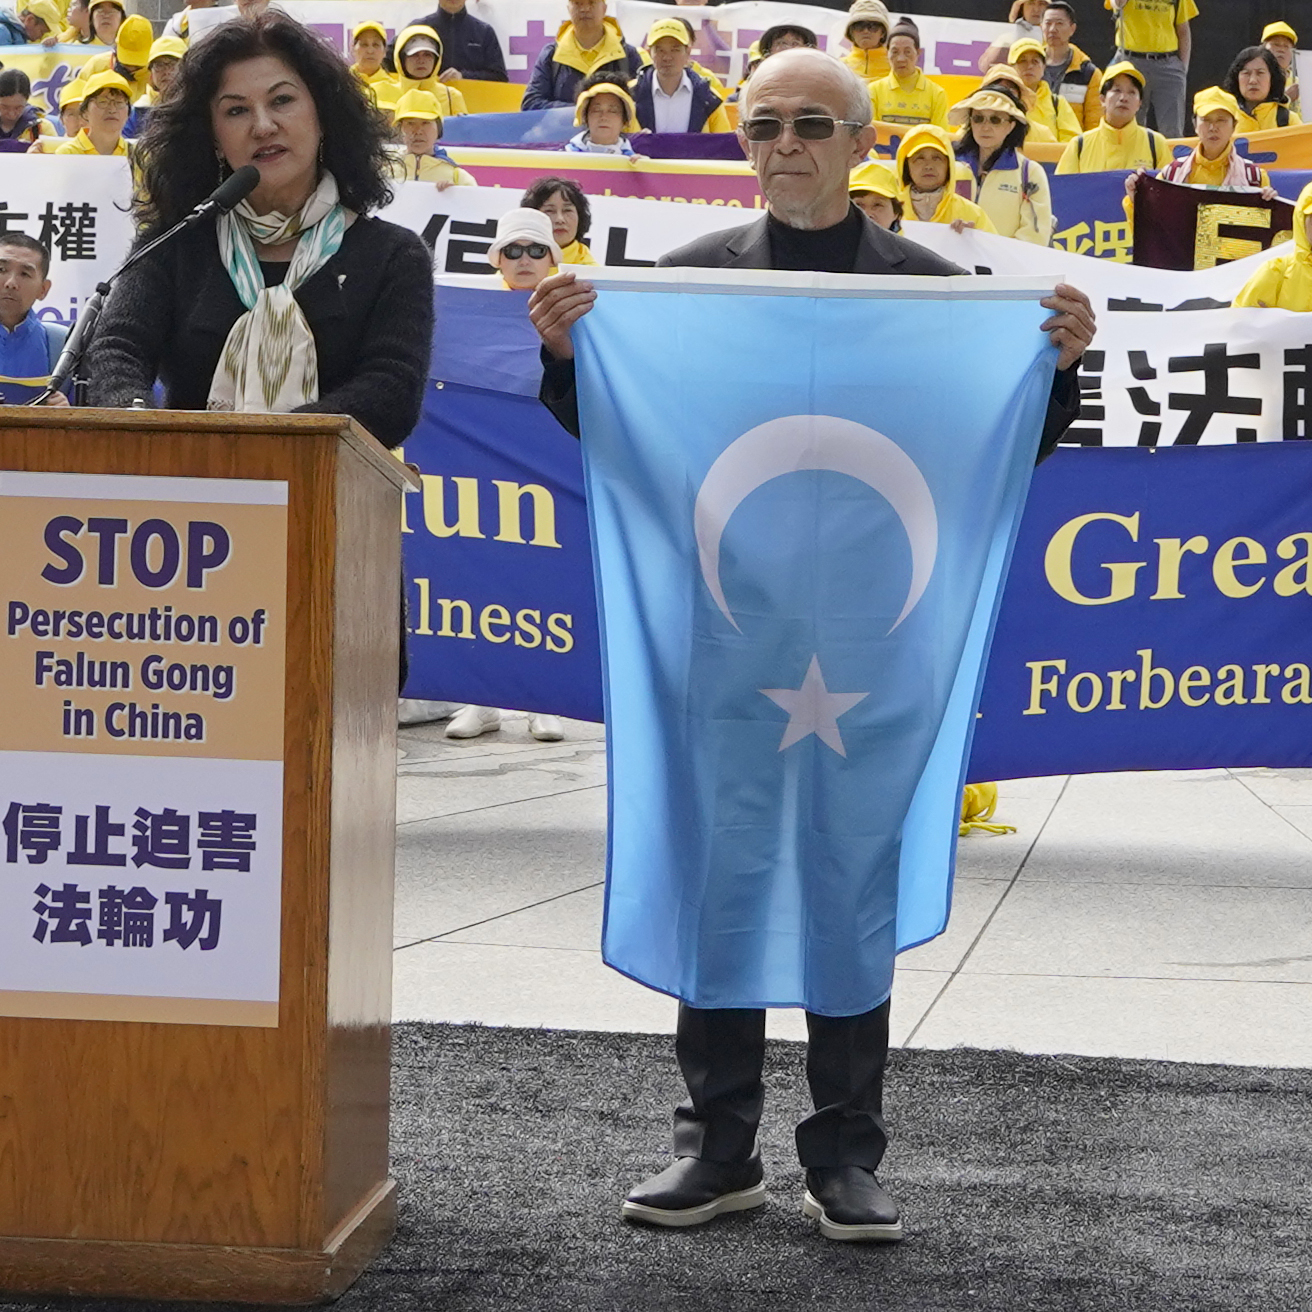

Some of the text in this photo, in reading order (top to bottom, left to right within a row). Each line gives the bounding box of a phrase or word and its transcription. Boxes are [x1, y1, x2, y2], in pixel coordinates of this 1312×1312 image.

[40, 514, 232, 589] STOP
[5, 600, 266, 646] Persecution of
[34, 650, 236, 700] Falun Gong
[61, 700, 205, 741] in China
[1, 801, 258, 873] 停止迫害
[31, 883, 224, 951] 法輪功
